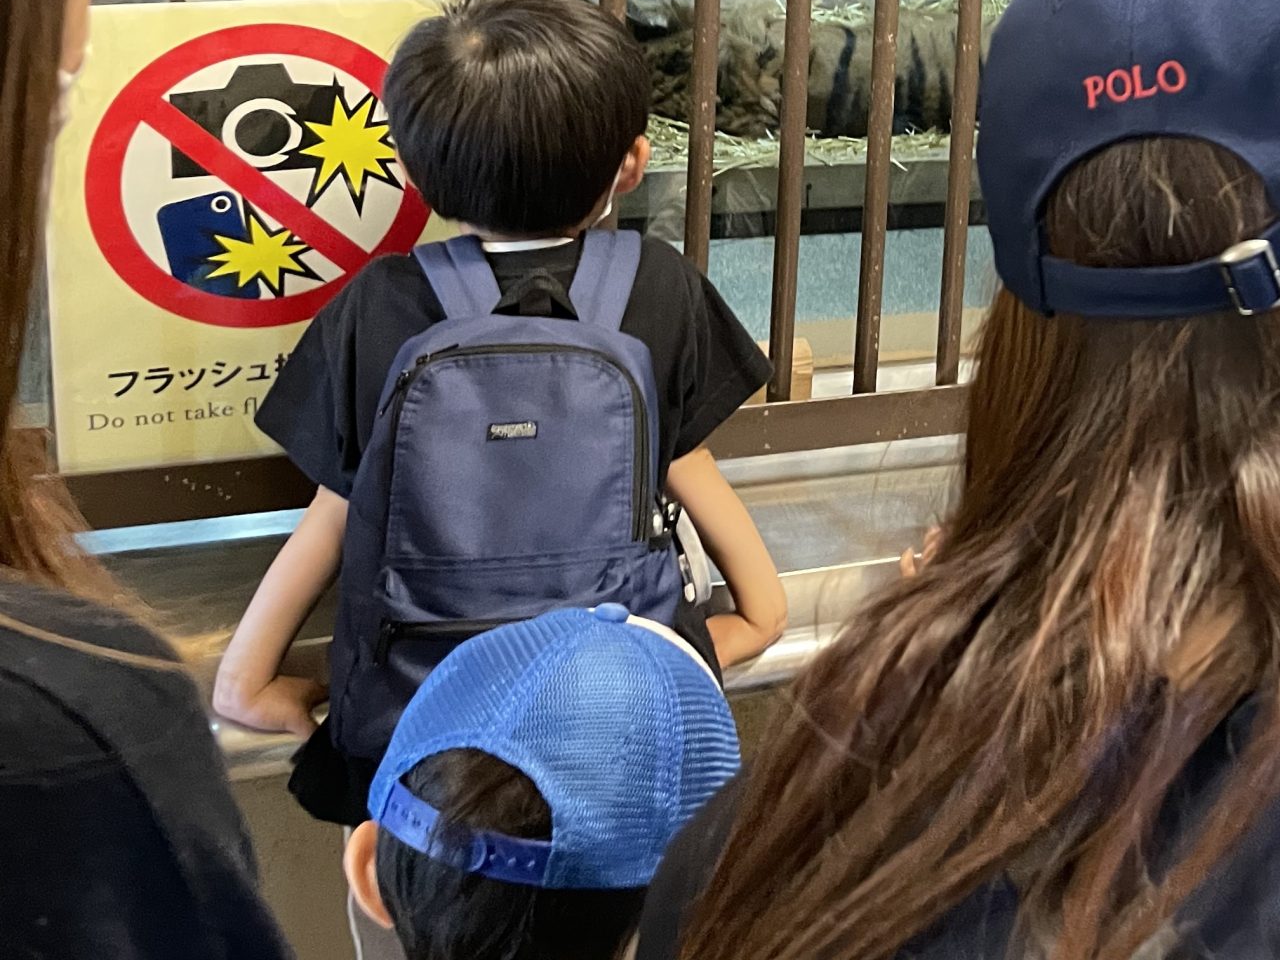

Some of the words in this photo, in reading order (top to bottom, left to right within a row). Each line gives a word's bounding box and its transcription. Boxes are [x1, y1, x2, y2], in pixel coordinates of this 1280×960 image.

[1083, 59, 1187, 110] POLO
[88, 413, 125, 431] Do
[135, 410, 174, 427] not
[185, 401, 234, 421] take
